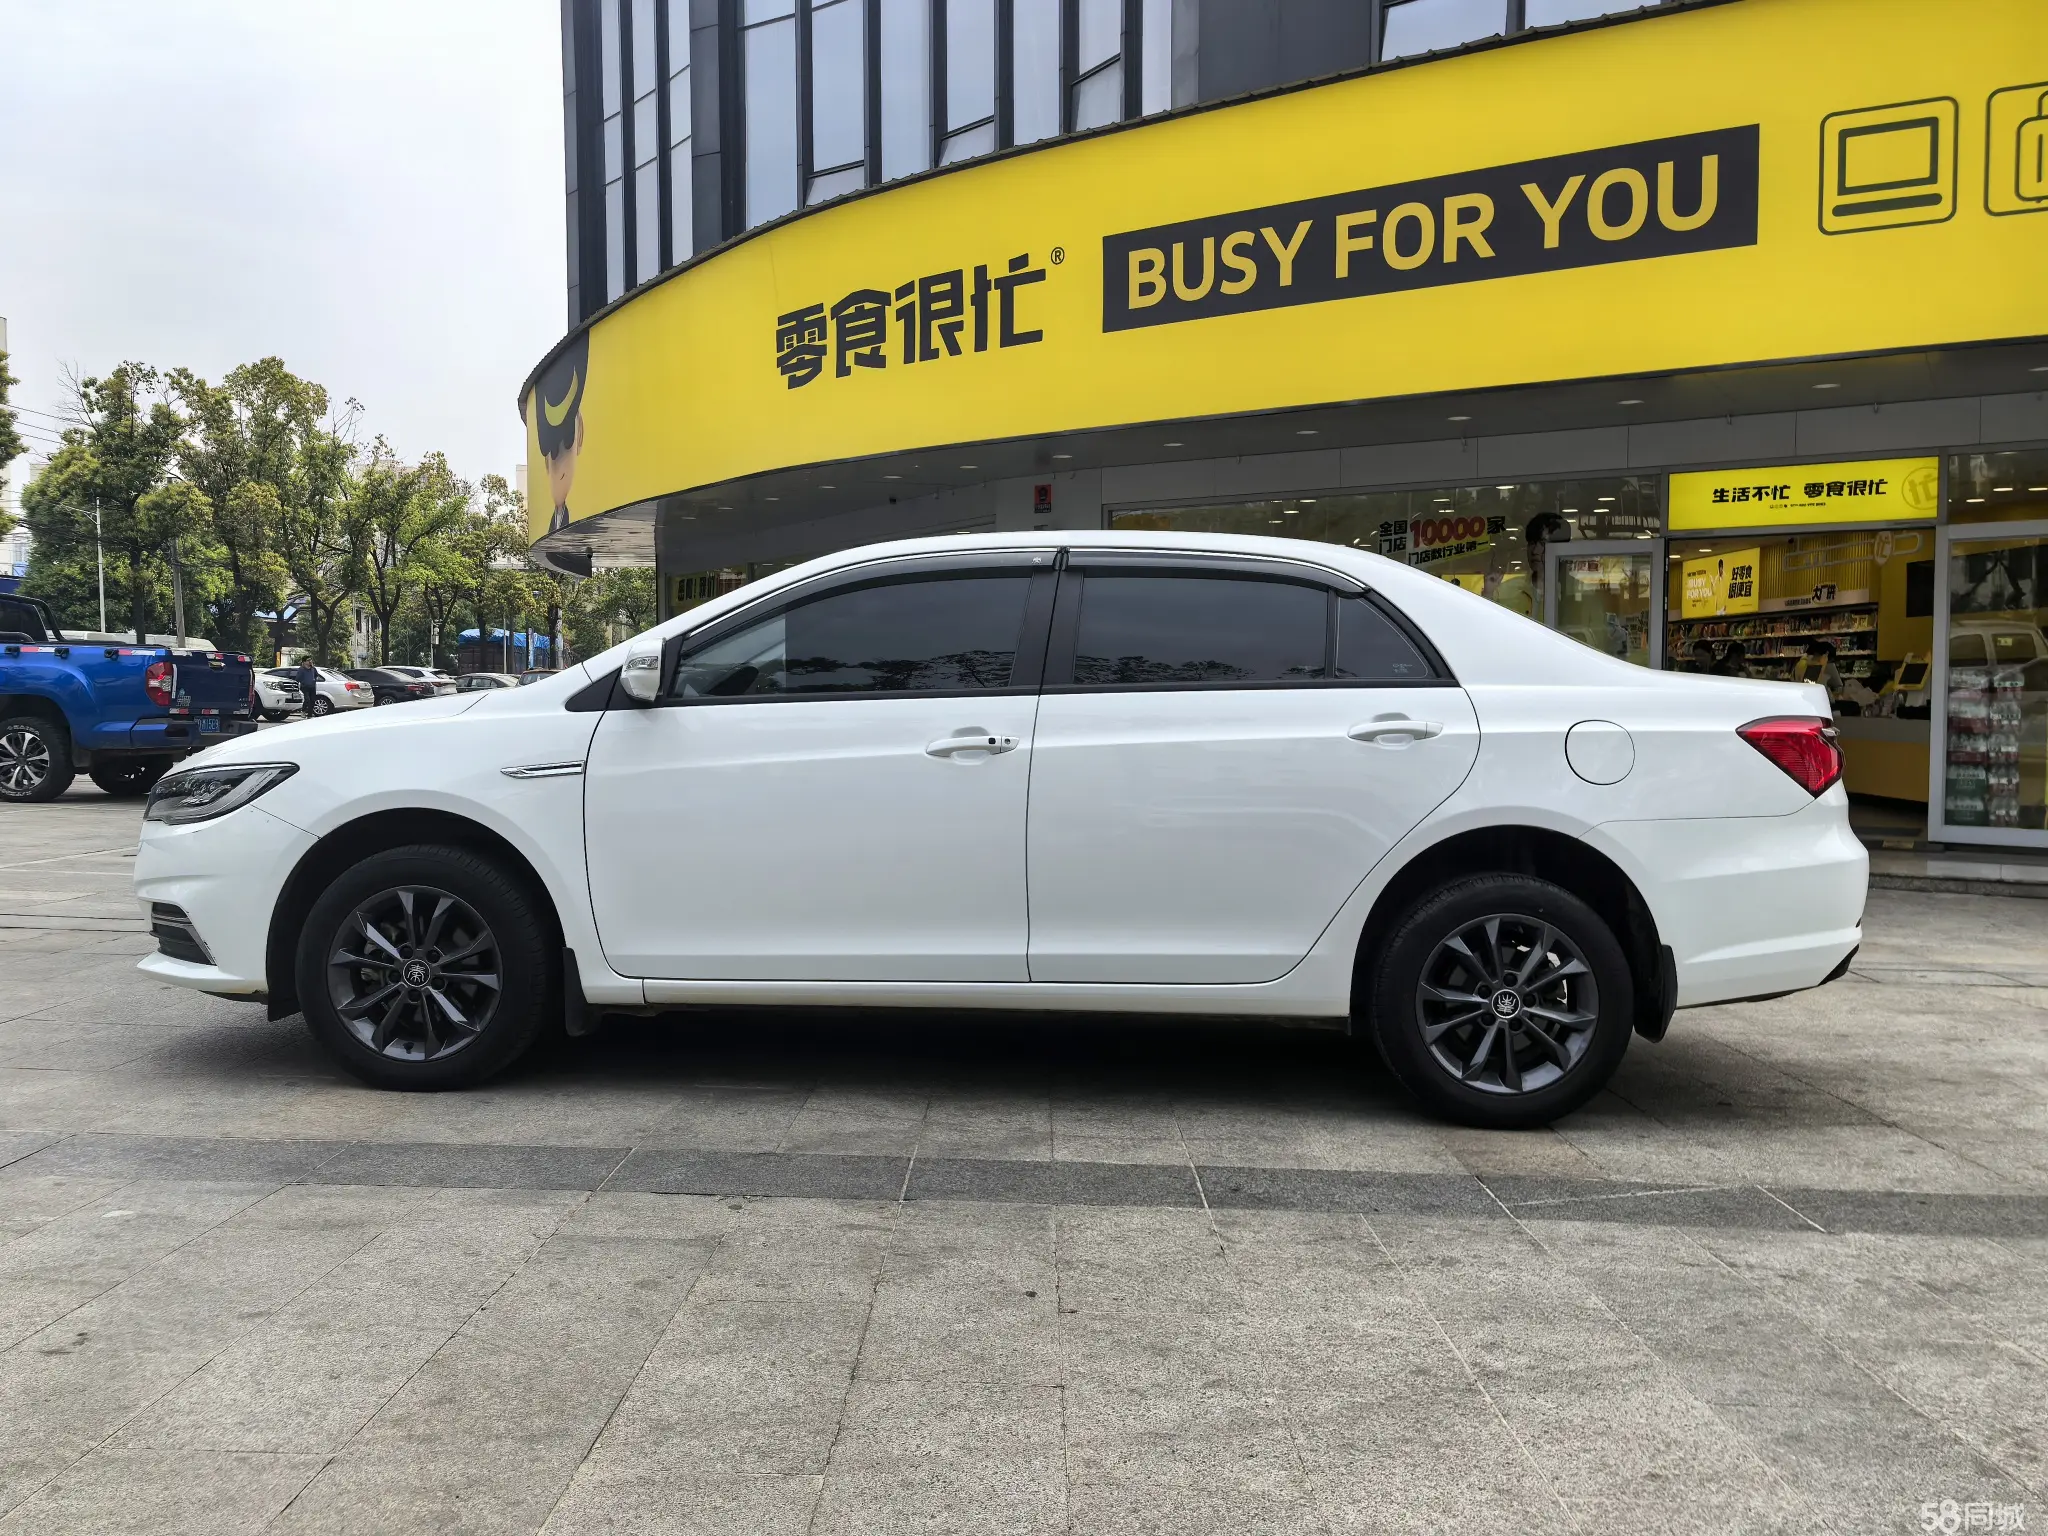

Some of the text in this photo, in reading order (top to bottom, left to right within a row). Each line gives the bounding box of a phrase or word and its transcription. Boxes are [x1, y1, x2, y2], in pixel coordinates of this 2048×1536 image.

[1128, 154, 1719, 310] BUSY FOR YOU
[775, 252, 1047, 390] 零食很忙
[1712, 478, 1889, 503] 生活不忙 零食很忙
[1379, 520, 1408, 538] 全国
[1379, 536, 1407, 556] 门店
[1408, 540, 1489, 567] 门店数行业第一
